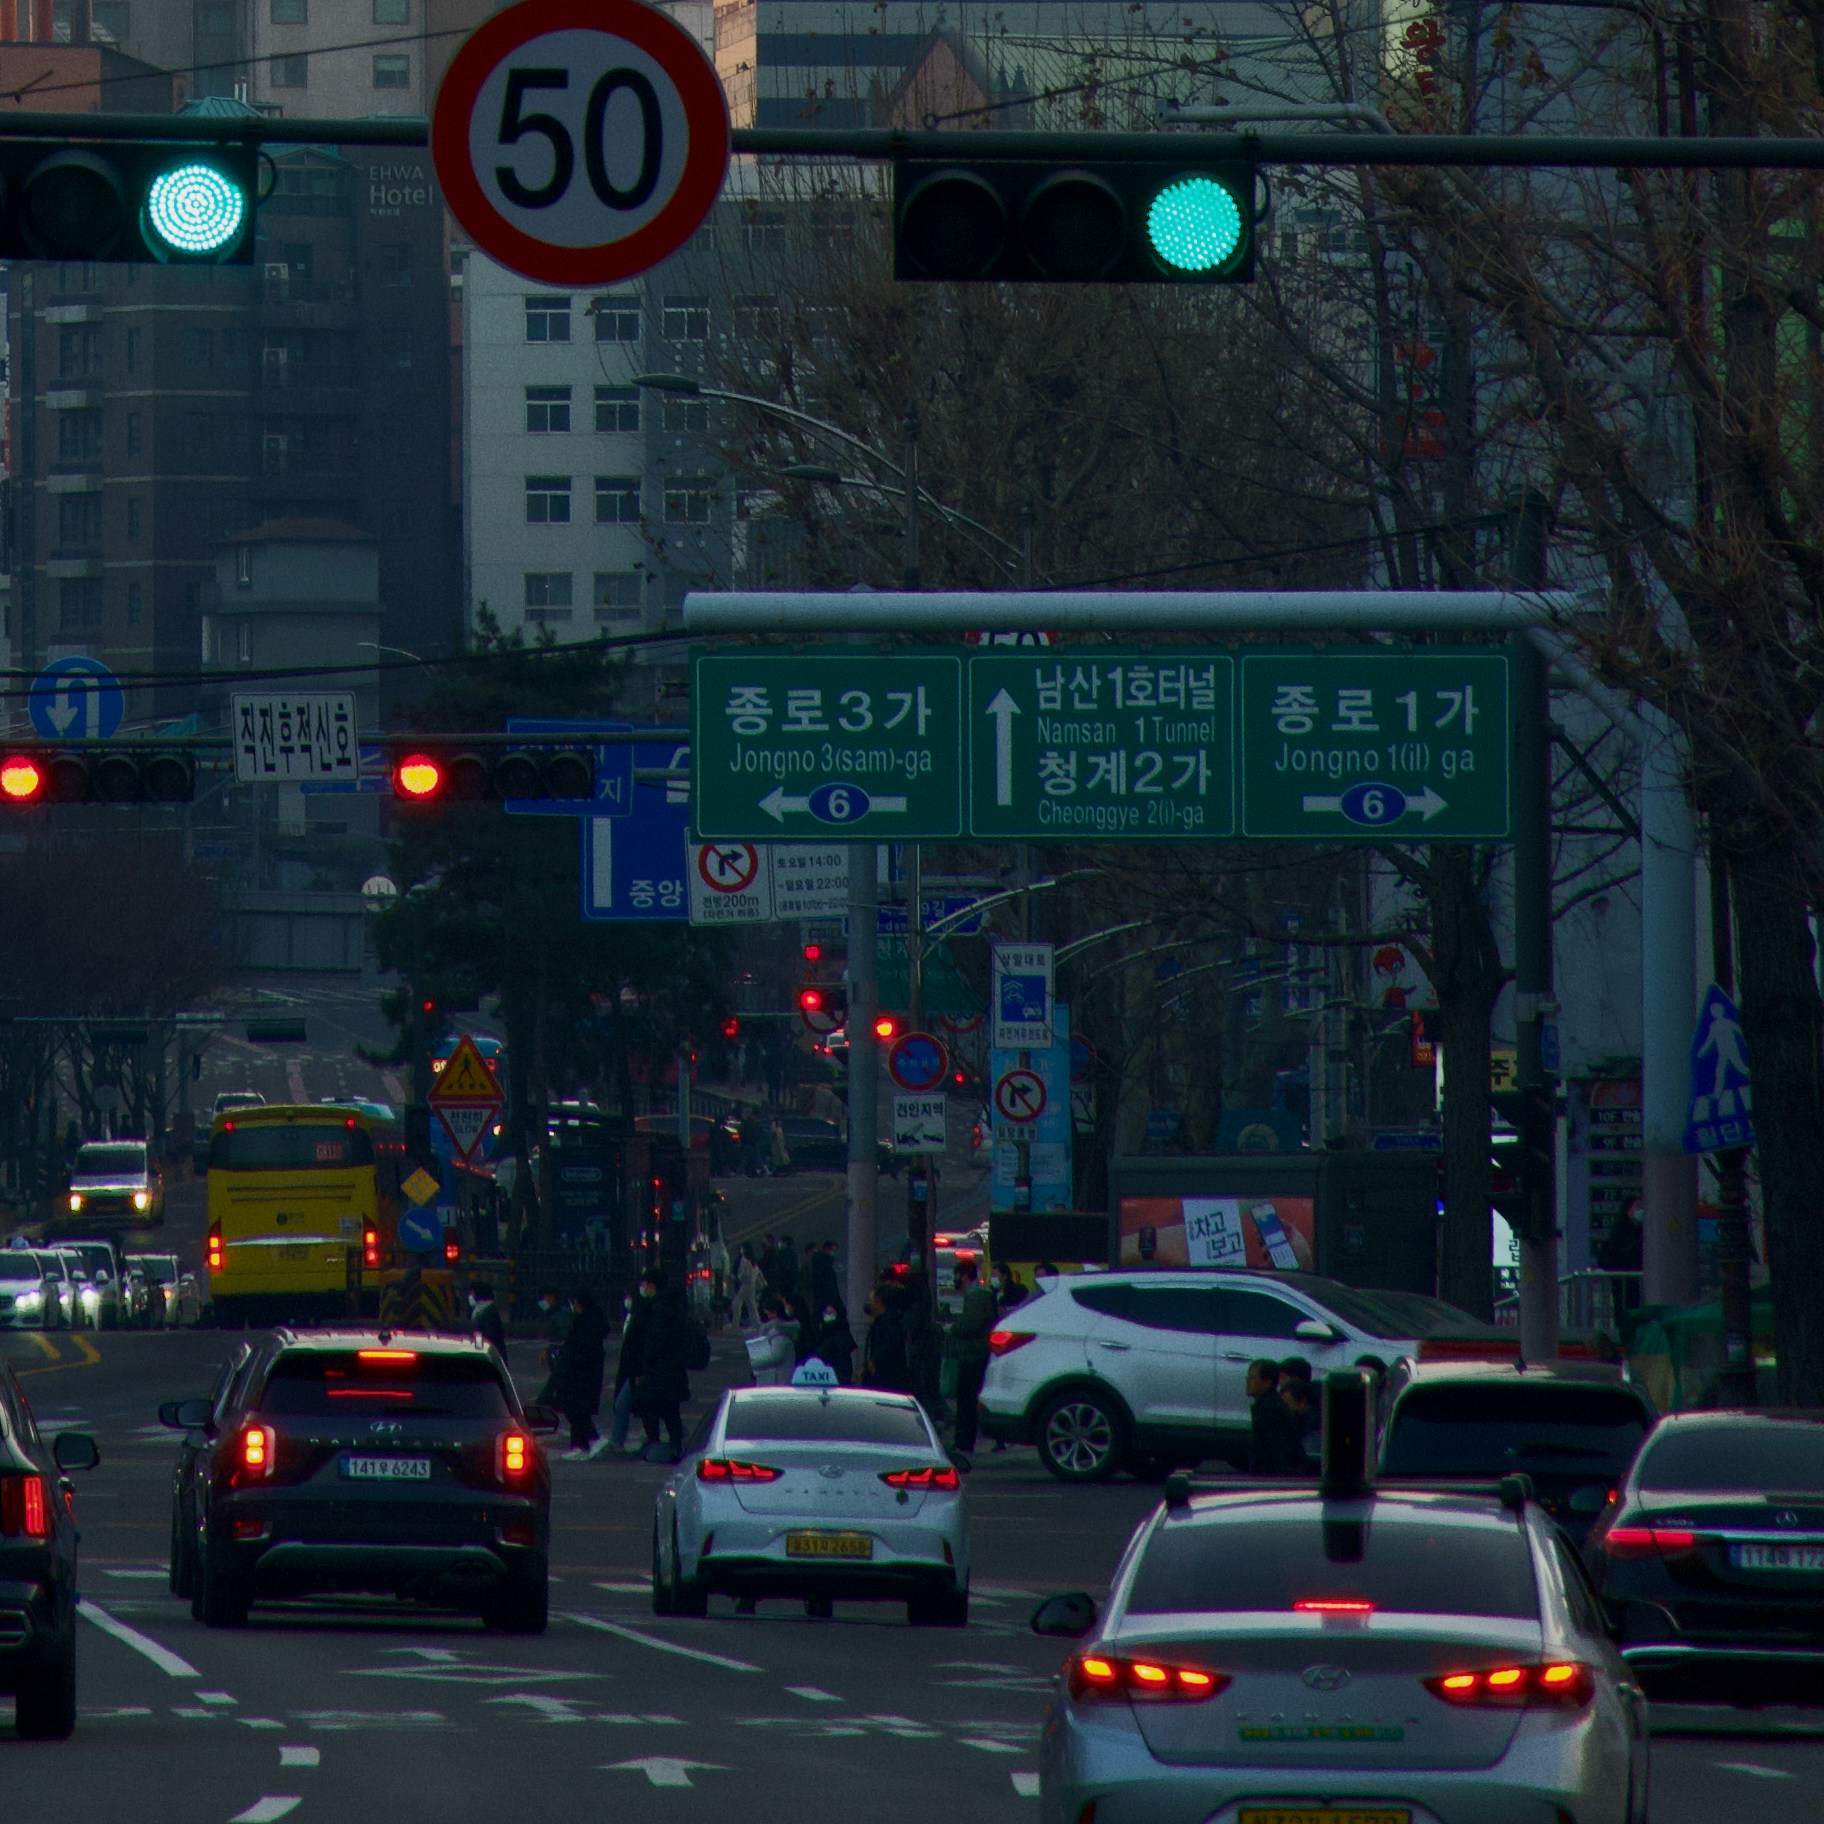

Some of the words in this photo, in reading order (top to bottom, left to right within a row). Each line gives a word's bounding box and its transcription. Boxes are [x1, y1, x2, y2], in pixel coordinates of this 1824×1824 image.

[495, 67, 663, 210] 50
[369, 165, 424, 180] EHWA
[369, 184, 433, 205] Hotel
[1035, 664, 1216, 711] 남산1호터널
[725, 685, 932, 736] 종로3가
[1271, 685, 1480, 735] 종로1가
[1037, 717, 1116, 743] Namsan
[1135, 716, 1144, 743] 1
[1151, 716, 1216, 743] Tunnel
[730, 742, 815, 779] Jongno
[821, 742, 932, 780] 3(sam)-ga
[1037, 749, 1212, 795] 청계2가
[1275, 742, 1380, 779] Jongno
[828, 788, 851, 818] 6
[1038, 799, 1139, 831] Cheonggye
[1147, 799, 1205, 831] 2(i)-ga
[1362, 789, 1385, 819] 6
[629, 878, 684, 909] 중앙
[817, 876, 849, 889] 22:00
[897, 1102, 944, 1118] 견인지역
[802, 1371, 829, 1382] TAXI
[392, 1461, 427, 1476] 6243
